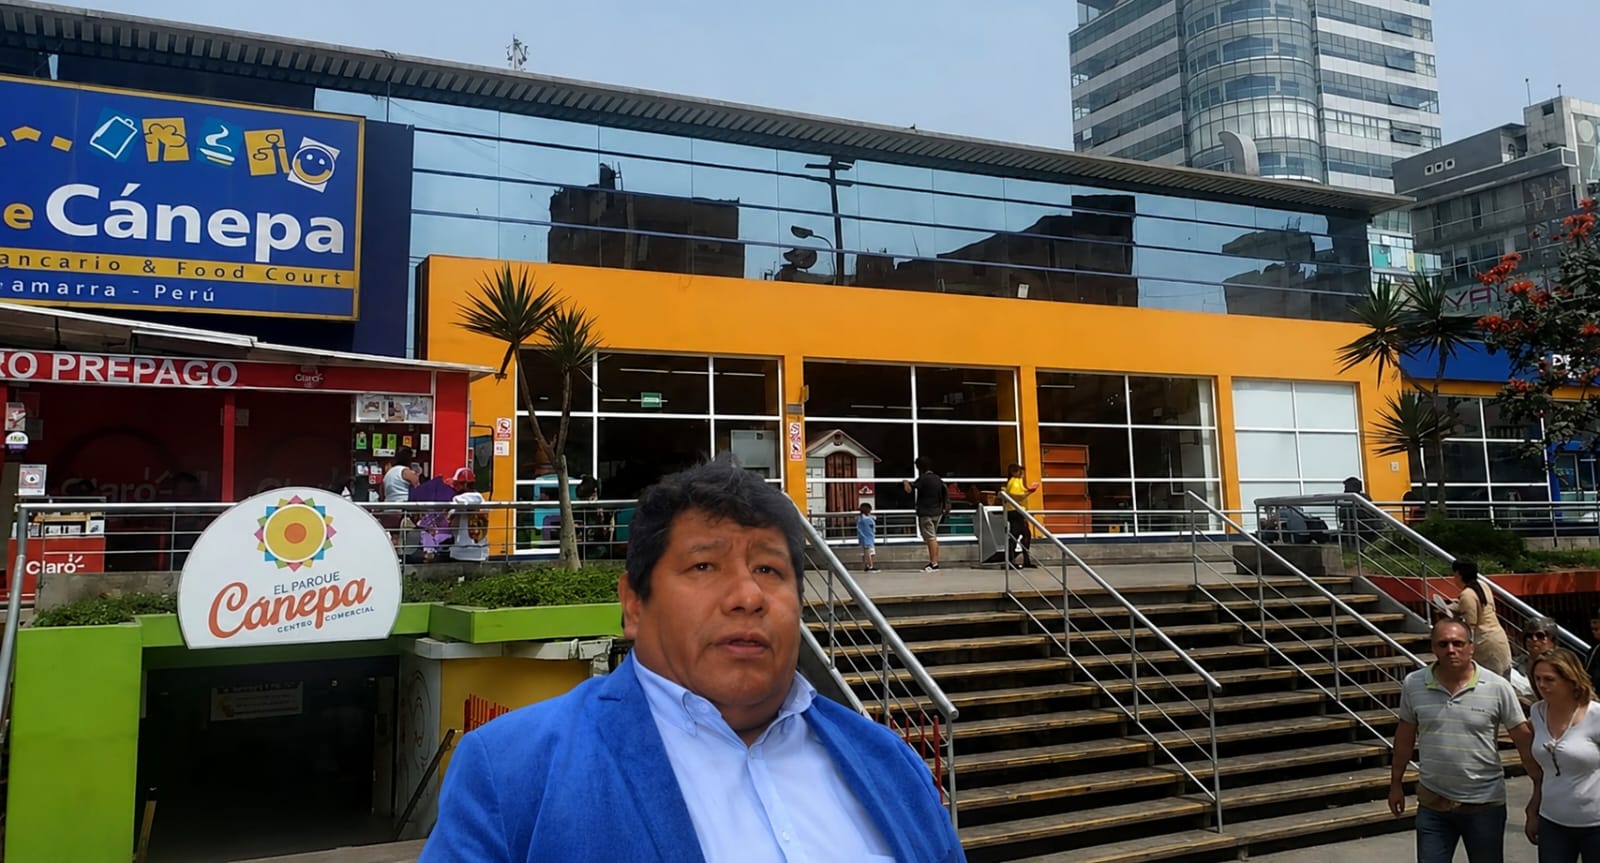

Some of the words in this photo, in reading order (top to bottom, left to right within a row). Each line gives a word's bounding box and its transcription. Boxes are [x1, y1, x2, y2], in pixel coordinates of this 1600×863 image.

[46, 183, 345, 262] Cánepa
[142, 259, 156, 274] &
[177, 261, 245, 280] Food
[265, 267, 342, 285] Court
[0, 279, 116, 297] amarra
[154, 283, 215, 302] Perú
[0, 351, 38, 379] O
[51, 352, 238, 387] PREPAGO
[294, 370, 321, 383] Claro
[26, 556, 80, 575] Claro
[273, 584, 289, 595] EL
[277, 620, 313, 633] CENTRO
[325, 606, 375, 622] COMERCIAL
